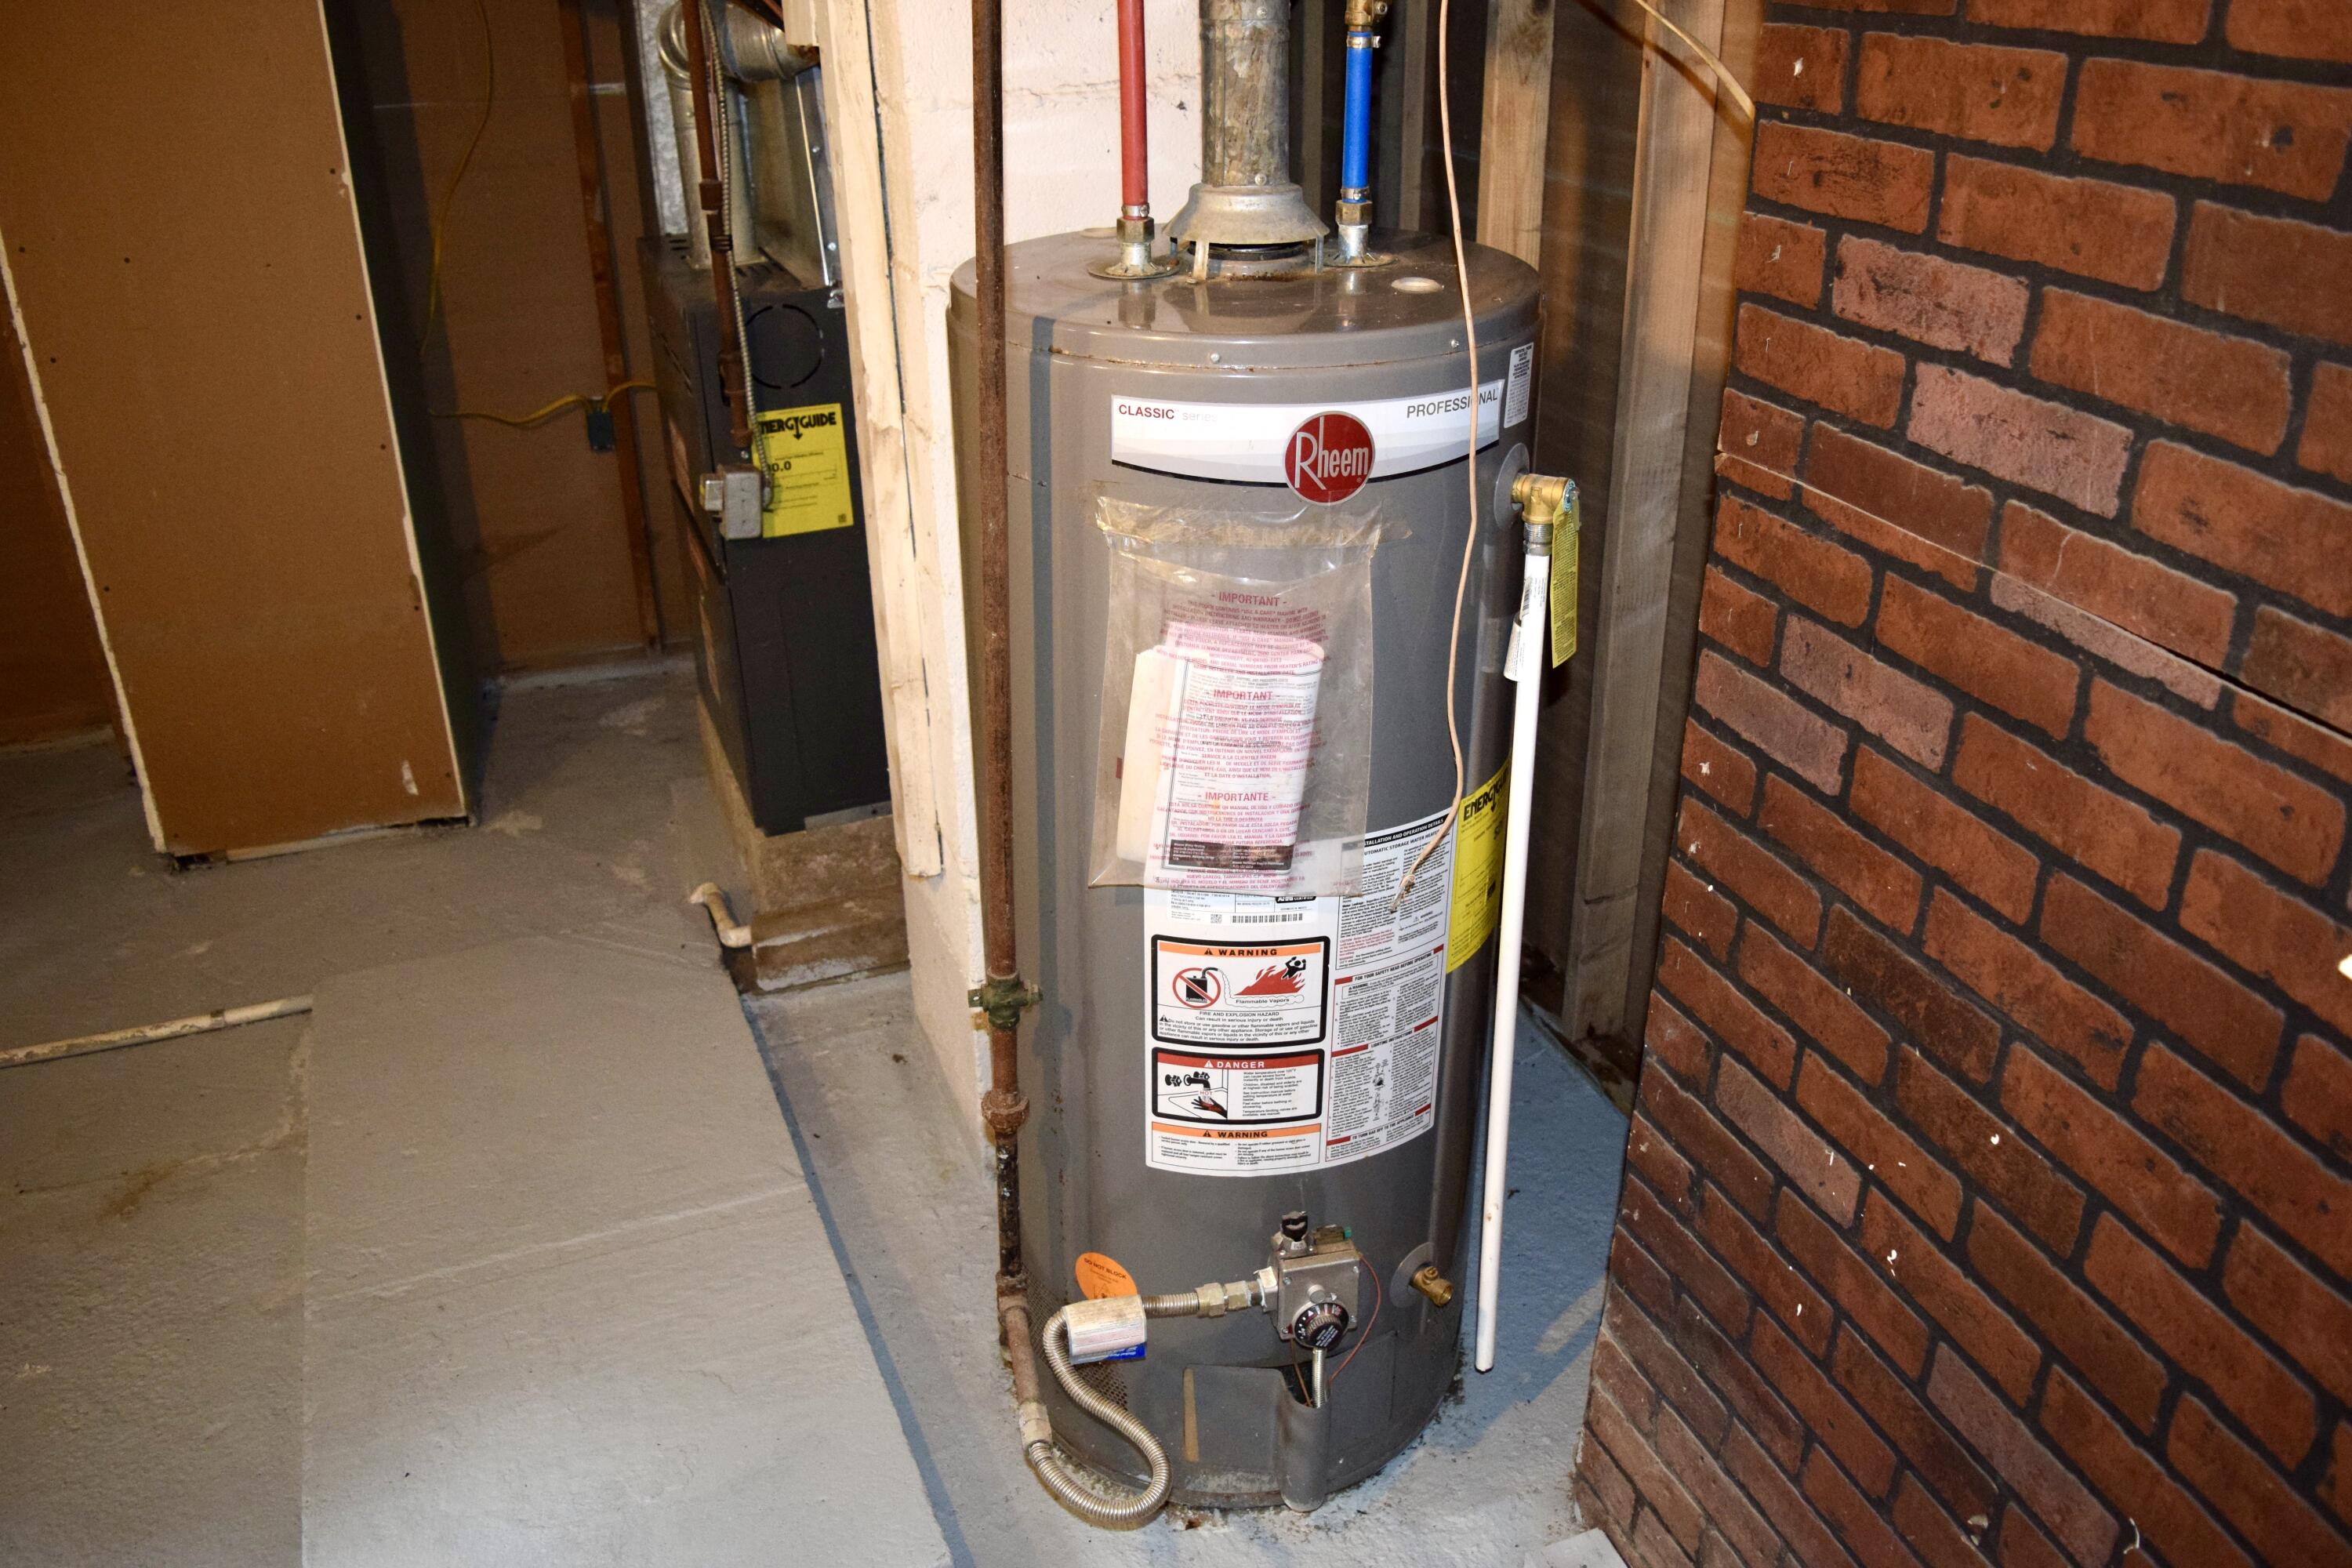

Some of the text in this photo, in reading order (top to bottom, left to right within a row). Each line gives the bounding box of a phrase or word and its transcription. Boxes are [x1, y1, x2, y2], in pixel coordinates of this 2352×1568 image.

[1119, 404, 1174, 419] CLASSIC
[1406, 388, 1498, 419] PROFESSINAL
[1294, 416, 1369, 490] Rheem
[767, 461, 792, 473] 0.0
[1218, 591, 1280, 608] IMPORTANT
[1214, 689, 1273, 700] IMPORTANT
[1205, 792, 1269, 801] IMPORTANTE
[1403, 826, 1427, 837] OPERATION
[1428, 818, 1443, 828] DETAILS
[1364, 847, 1388, 855] UTOMATIC
[1093, 1262, 1105, 1271] NOT
[1106, 1268, 1127, 1279] BLOCK
